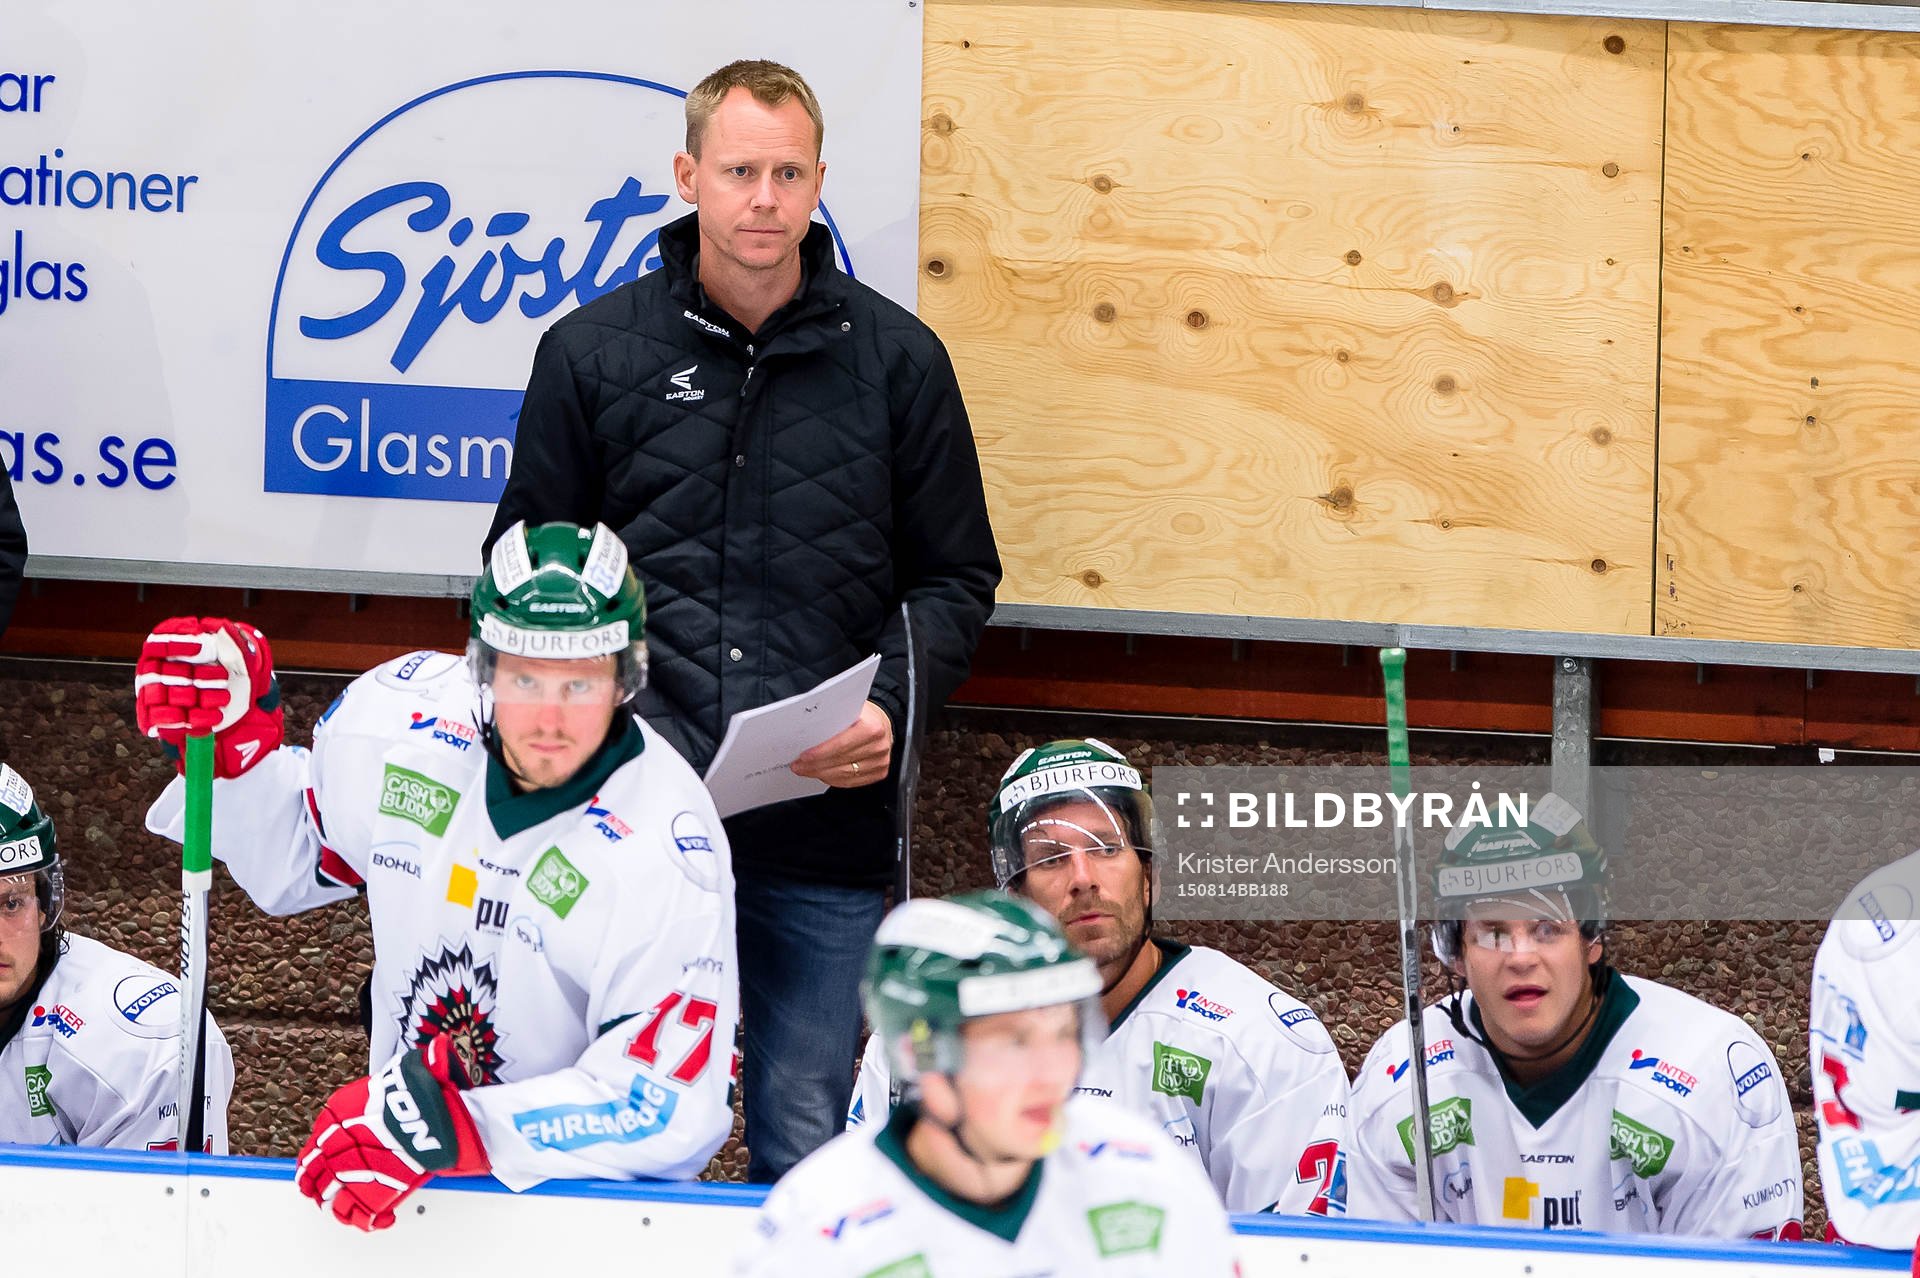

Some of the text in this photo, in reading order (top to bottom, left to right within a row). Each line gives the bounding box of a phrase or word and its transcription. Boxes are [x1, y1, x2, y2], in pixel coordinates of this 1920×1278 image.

[0, 148, 199, 212] ationer
[0, 230, 88, 317] las
[665, 390, 705, 400] EASTON
[529, 602, 588, 613] EASTON
[507, 626, 623, 654] BJURFORS
[437, 718, 477, 740] INTER
[1038, 751, 1092, 766] EASTON
[386, 776, 429, 804] CASH
[1030, 765, 1138, 792] BJURFORS
[382, 791, 434, 823] BUDDY
[1463, 858, 1577, 891] BJURFORS
[125, 983, 175, 1017] VOLVO
[1188, 1003, 1228, 1022] SPORT
[1196, 996, 1233, 1016] INTER
[622, 989, 718, 1087] 17
[1651, 1071, 1692, 1097] SPORT
[1658, 1060, 1698, 1088] INTER
[1519, 1154, 1575, 1164] EASTON
